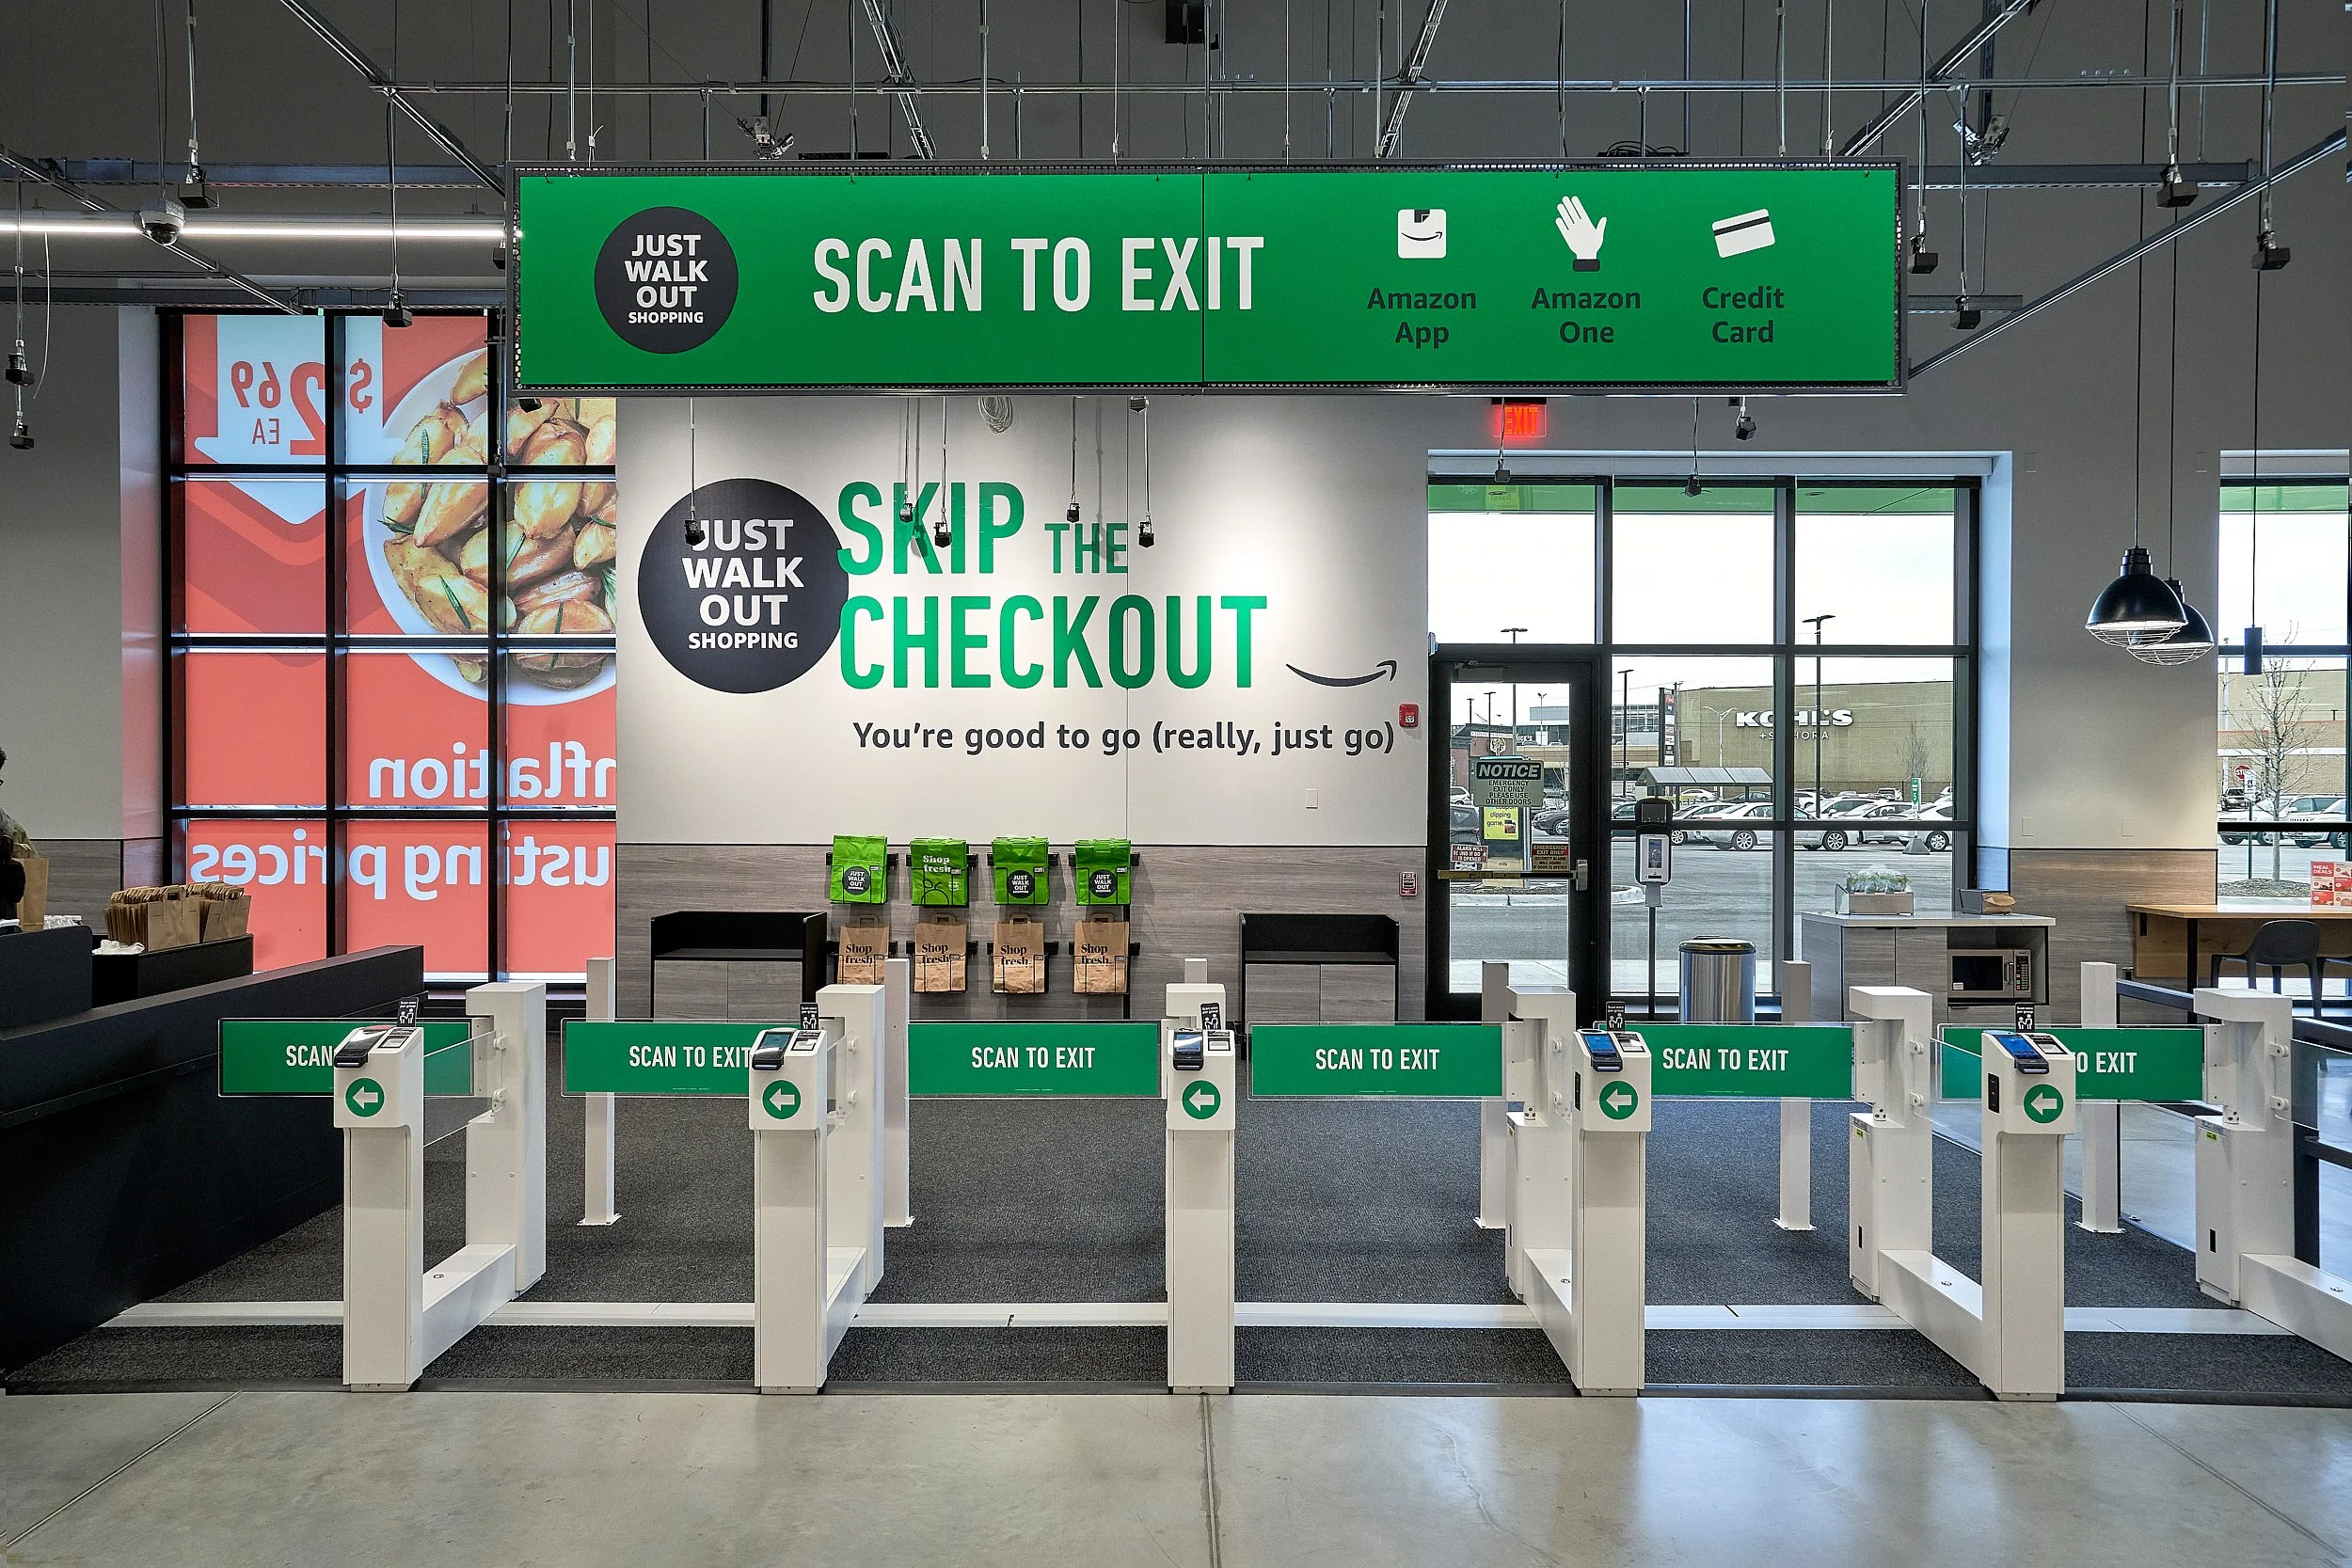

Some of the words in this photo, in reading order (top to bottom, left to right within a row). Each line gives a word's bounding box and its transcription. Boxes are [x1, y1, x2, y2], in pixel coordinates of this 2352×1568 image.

[632, 234, 701, 256] JUST
[625, 261, 707, 281] WALK
[814, 237, 981, 313] SCAN
[1011, 236, 1091, 312] TO
[1122, 236, 1264, 311] EXIT
[636, 286, 697, 308] OUT
[1367, 287, 1476, 309] Amazon
[1532, 287, 1641, 309] Amazon
[1702, 285, 1785, 309] Credit
[628, 312, 704, 325] SHOPPING
[1395, 321, 1450, 350] App
[1559, 321, 1614, 344] One
[1711, 320, 1774, 343] Card
[1504, 406, 1538, 434] EXIT
[691, 519, 794, 551] JUST
[836, 482, 1025, 576] SKIP
[1044, 523, 1128, 574] THE
[682, 557, 804, 589] WALK
[700, 594, 788, 626] OUT
[689, 632, 799, 649] SHOPPING
[840, 594, 1268, 689] CHECKOUT
[966, 721, 1044, 756] good
[1057, 725, 1089, 749] to
[1103, 728, 1140, 756] go
[1152, 721, 1261, 756] (really,
[1271, 721, 1333, 756] just
[1345, 721, 1394, 756] go)
[1478, 764, 1539, 778] NOTICE
[923, 855, 950, 864] Shop
[845, 944, 872, 955] Shop
[921, 943, 948, 954] Shop
[1000, 945, 1027, 956] Shop
[1081, 943, 1108, 955] Shop
[286, 1045, 333, 1067] SCAN
[629, 1045, 676, 1068] SCAN
[683, 1046, 706, 1068] TO
[713, 1046, 752, 1069] EXIT
[971, 1046, 1019, 1069] SCAN
[1025, 1046, 1049, 1069] TO
[1056, 1047, 1096, 1069] EXIT
[1315, 1048, 1363, 1070] SCAN
[1370, 1048, 1393, 1070] TO
[1400, 1048, 1440, 1070] EXIT
[1662, 1047, 1710, 1069] SCAN
[1717, 1048, 1740, 1070] TO
[1748, 1049, 1789, 1071] EXIT
[2074, 1052, 2089, 1073] O
[2095, 1052, 2137, 1073] EXIT
